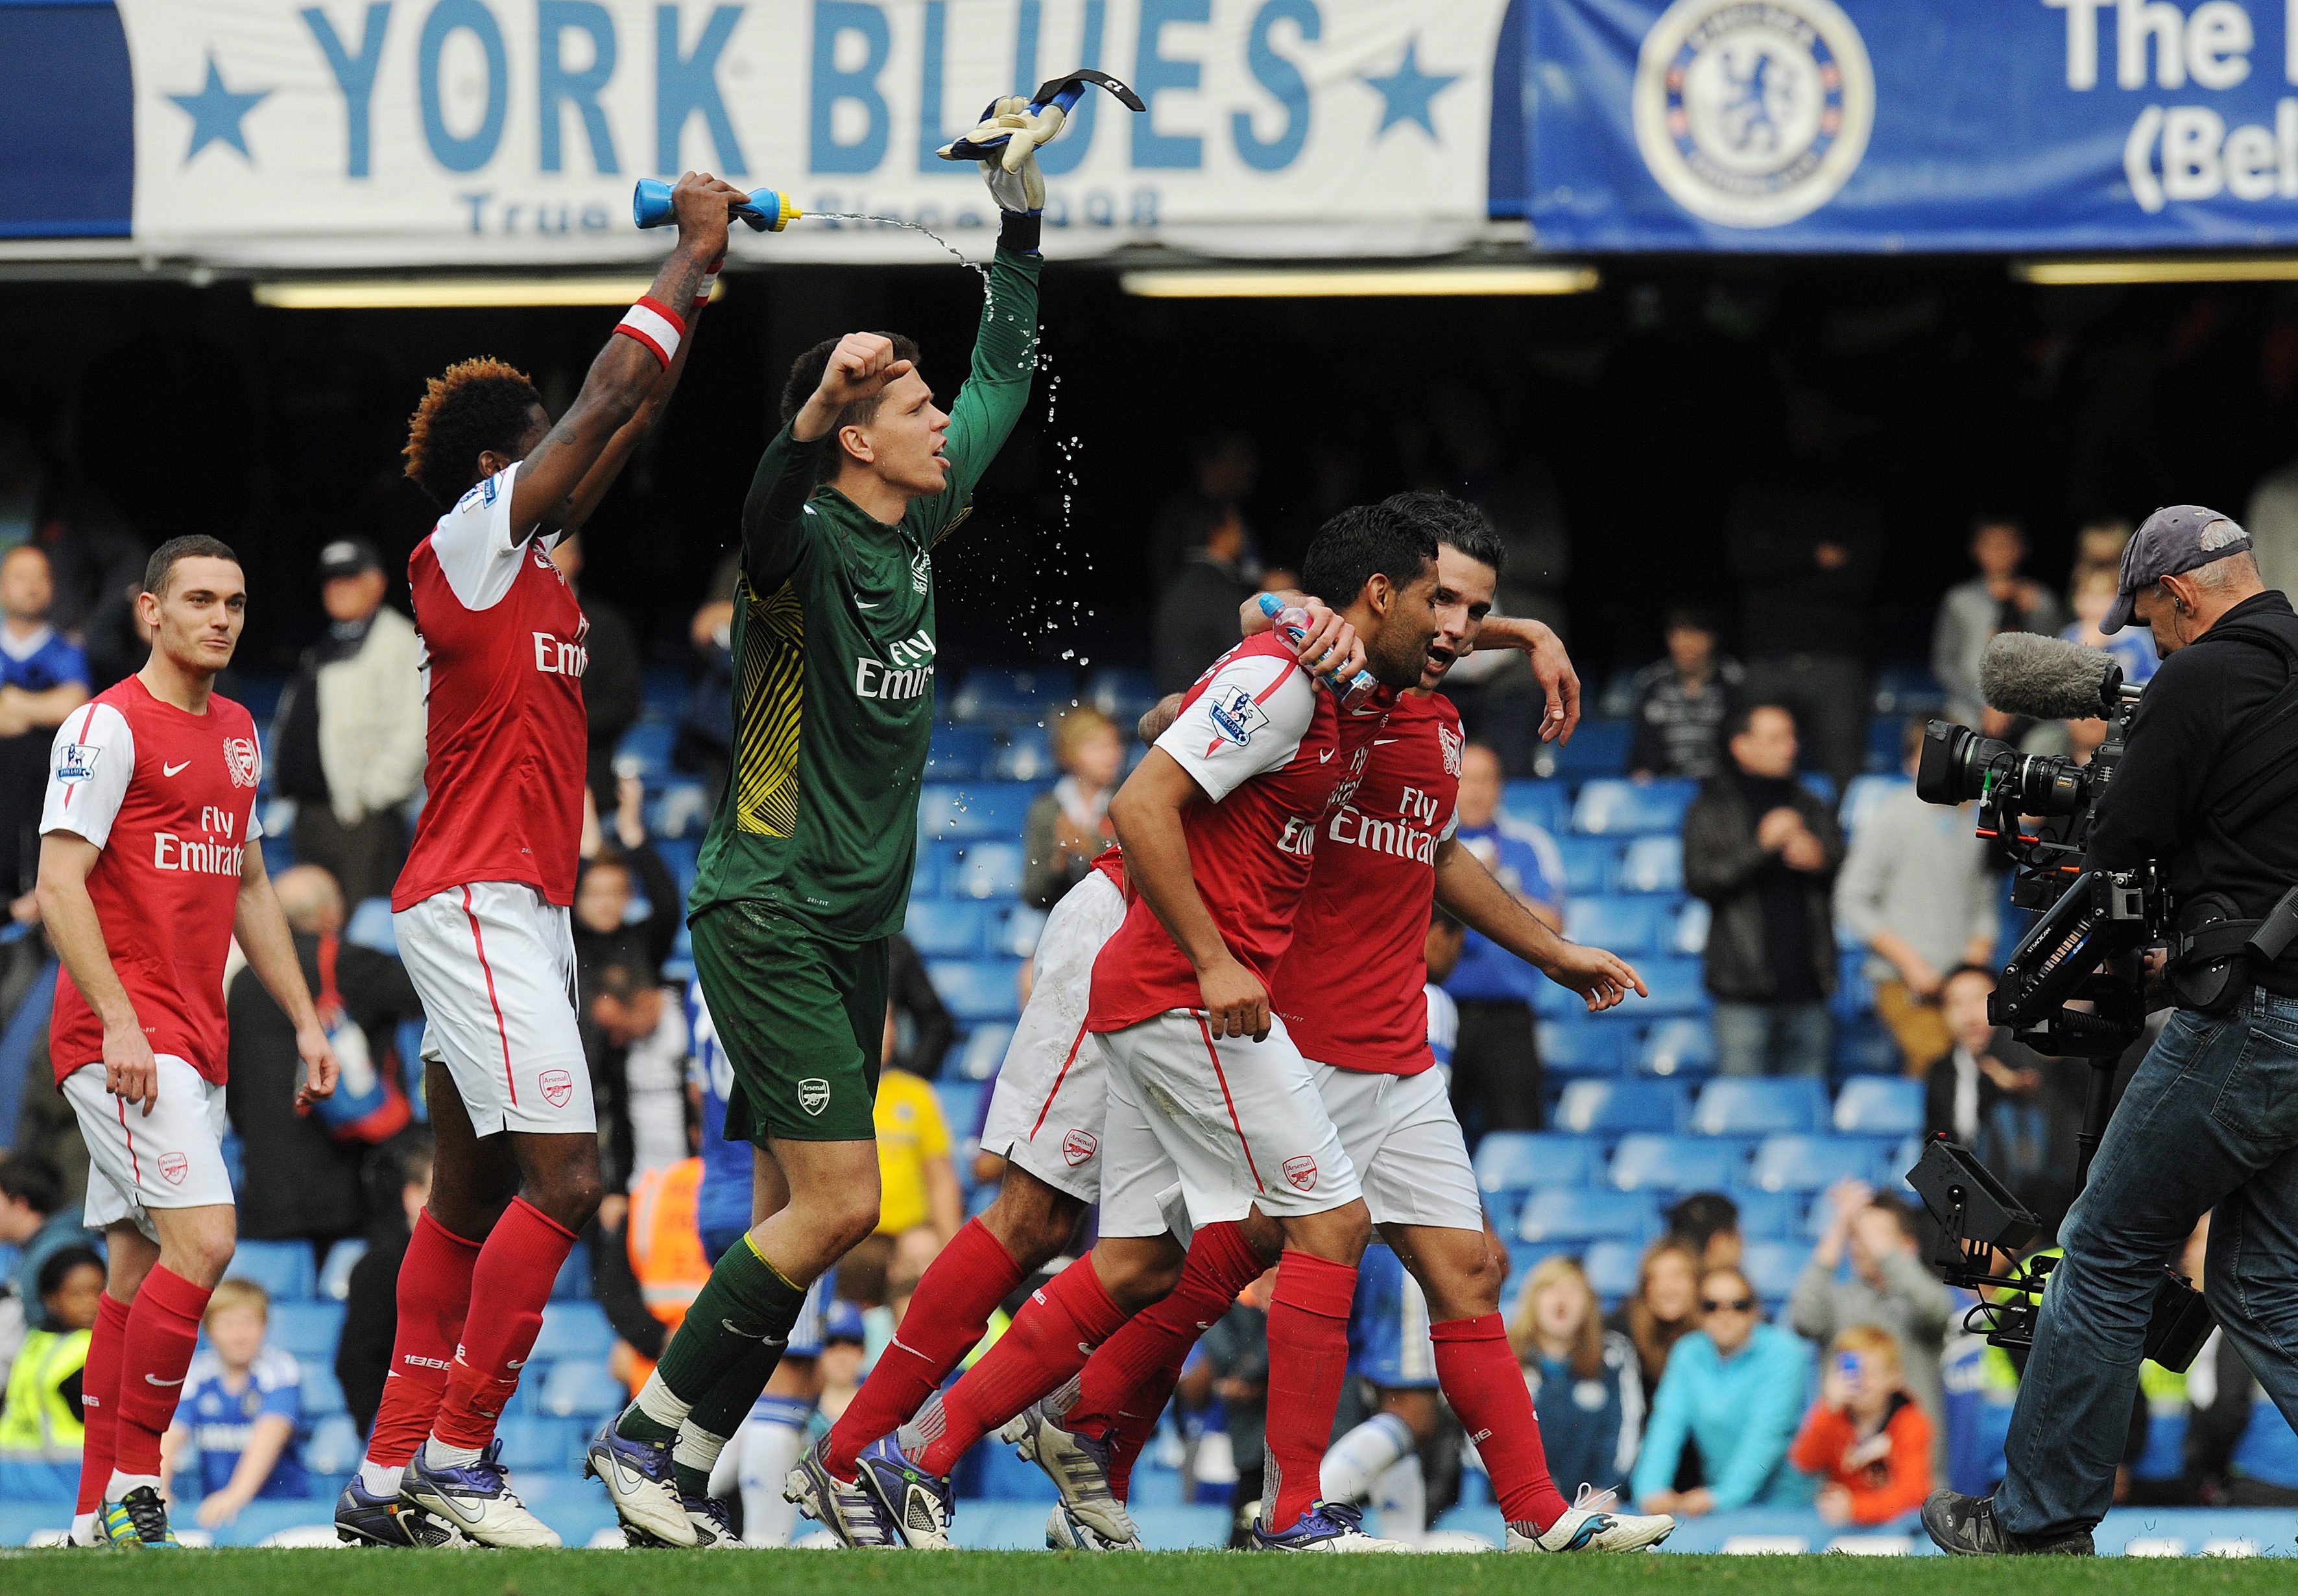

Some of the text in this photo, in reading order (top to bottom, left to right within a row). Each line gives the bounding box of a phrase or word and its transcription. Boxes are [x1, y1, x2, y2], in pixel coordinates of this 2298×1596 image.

[2042, 0, 2255, 91] The
[298, 0, 1321, 178] YORK BLUES
[456, 191, 610, 233] True
[815, 192, 985, 230] Since
[1040, 187, 1161, 228] 998
[889, 629, 937, 667] Fly
[1215, 709, 1241, 734] BARCLAYS
[201, 805, 234, 839] Fly
[1398, 786, 1439, 826] Fly
[1071, 1134, 1092, 1147] Arsenal
[1287, 1161, 1310, 1171] Arsenal
[1293, 1533, 1311, 1544] A&S
